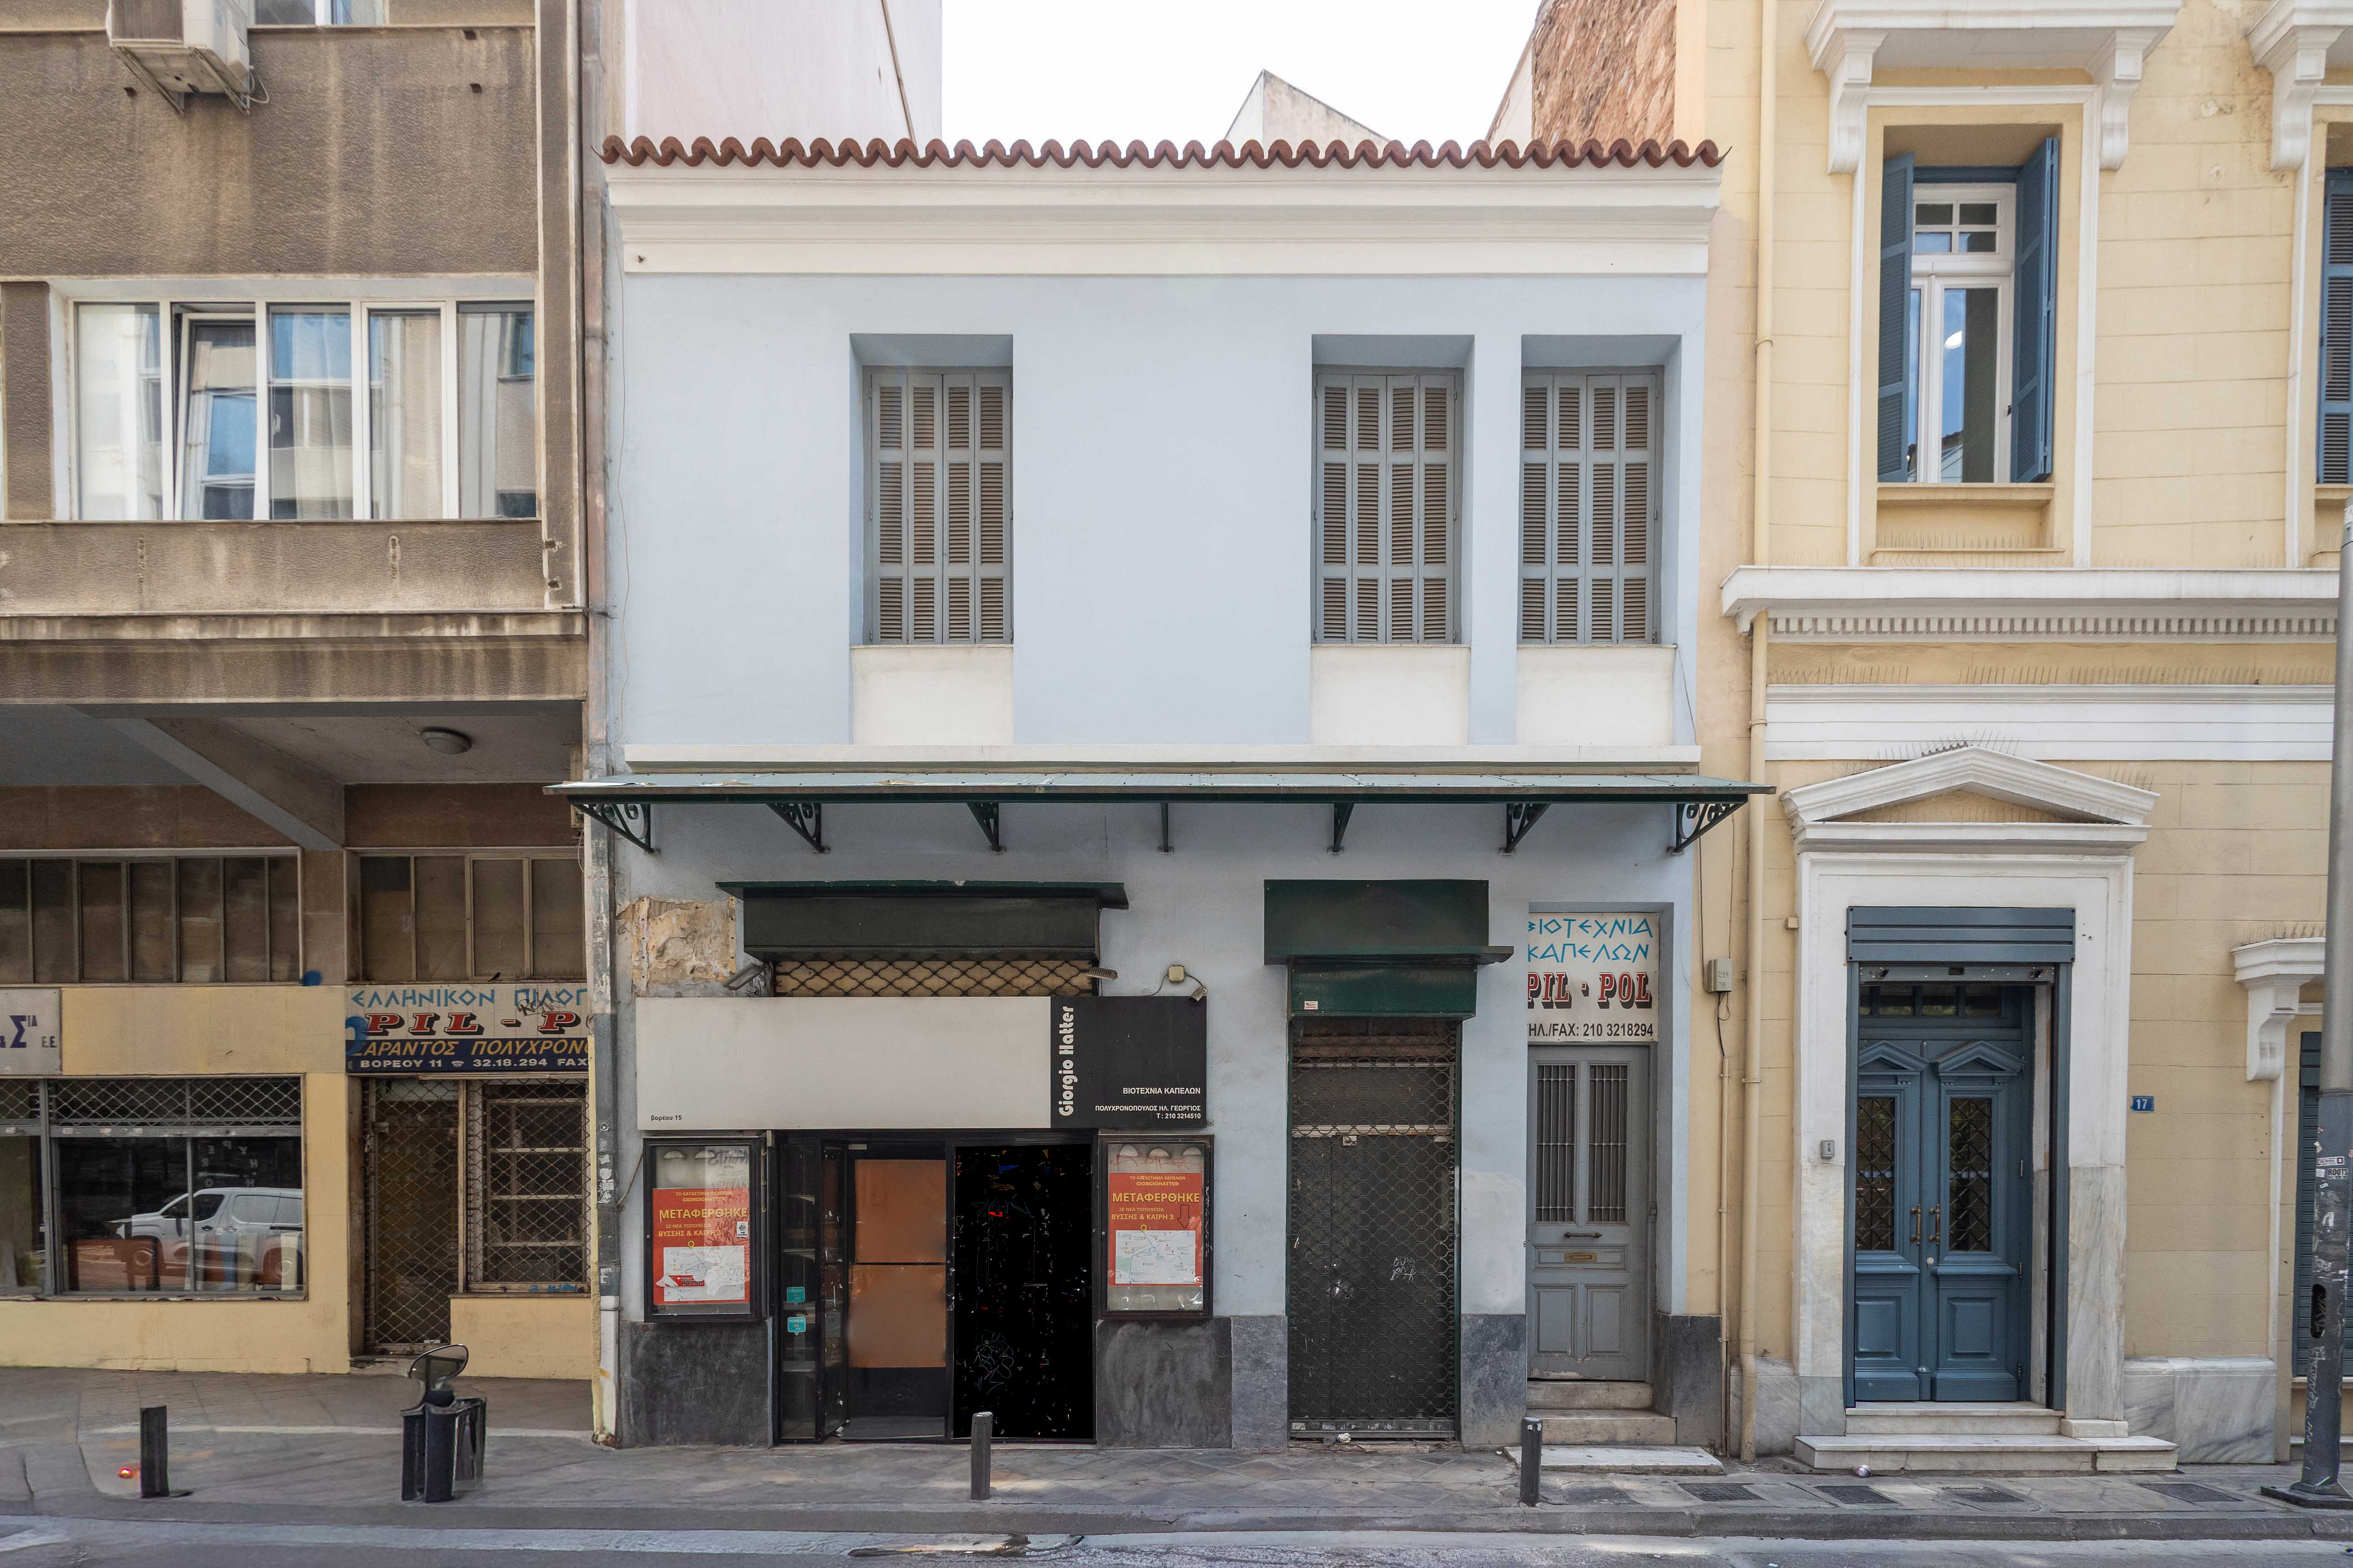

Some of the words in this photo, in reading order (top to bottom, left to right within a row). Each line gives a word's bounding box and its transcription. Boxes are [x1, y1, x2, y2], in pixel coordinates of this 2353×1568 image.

[1528, 943, 1649, 963] ΚΑΠΕΛΩΝ
[352, 988, 495, 1008] ΕΛΛΗΝΙΚΟΝ
[1598, 971, 1652, 1009] POL
[361, 1012, 485, 1037] PIL
[538, 1011, 589, 1035] P
[1059, 1006, 1074, 1055] Hatter
[1527, 1023, 1579, 1037] ΗΛ./FAX:
[1583, 1023, 1603, 1037] 210
[1606, 1023, 1654, 1037] 3218294
[352, 1040, 460, 1057] ΑΡΑΝΤΟΣ
[360, 1060, 423, 1068] ΒΟΡΕΟΥ
[429, 1060, 442, 1068] 11
[472, 1058, 548, 1067] 32.18.294
[557, 1058, 588, 1067] FAX
[1058, 1060, 1078, 1117] Giorgio
[2136, 1098, 2148, 1110] 17
[1112, 1192, 1200, 1203] ΜΕΤΑΦΕΡΘΗΚΕ
[659, 1207, 747, 1219] ΜΕΤΑΦΕΡΘΗΚΕ
